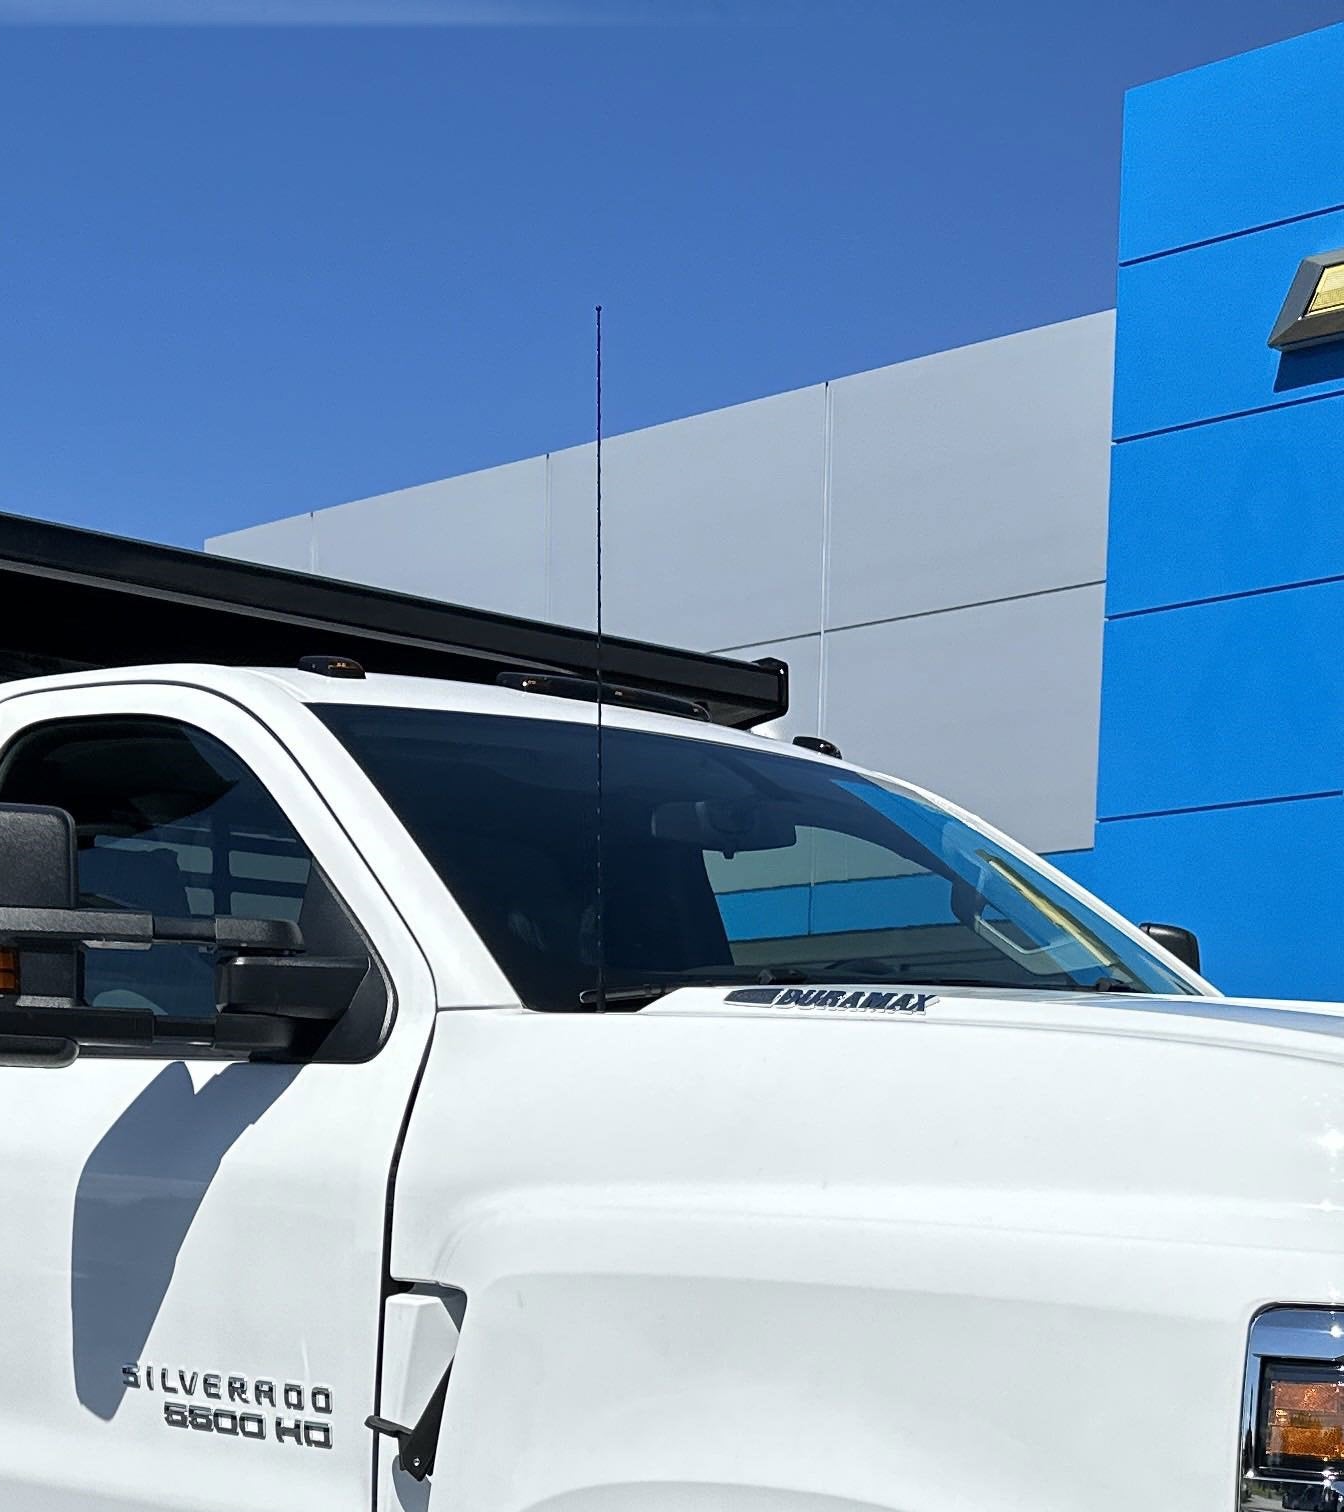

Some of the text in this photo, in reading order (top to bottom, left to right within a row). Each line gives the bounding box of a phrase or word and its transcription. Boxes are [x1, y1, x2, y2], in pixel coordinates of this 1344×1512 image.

[775, 988, 938, 1014] DURAMAX
[121, 1362, 334, 1414] SILVERADO
[275, 1415, 334, 1449] HD
